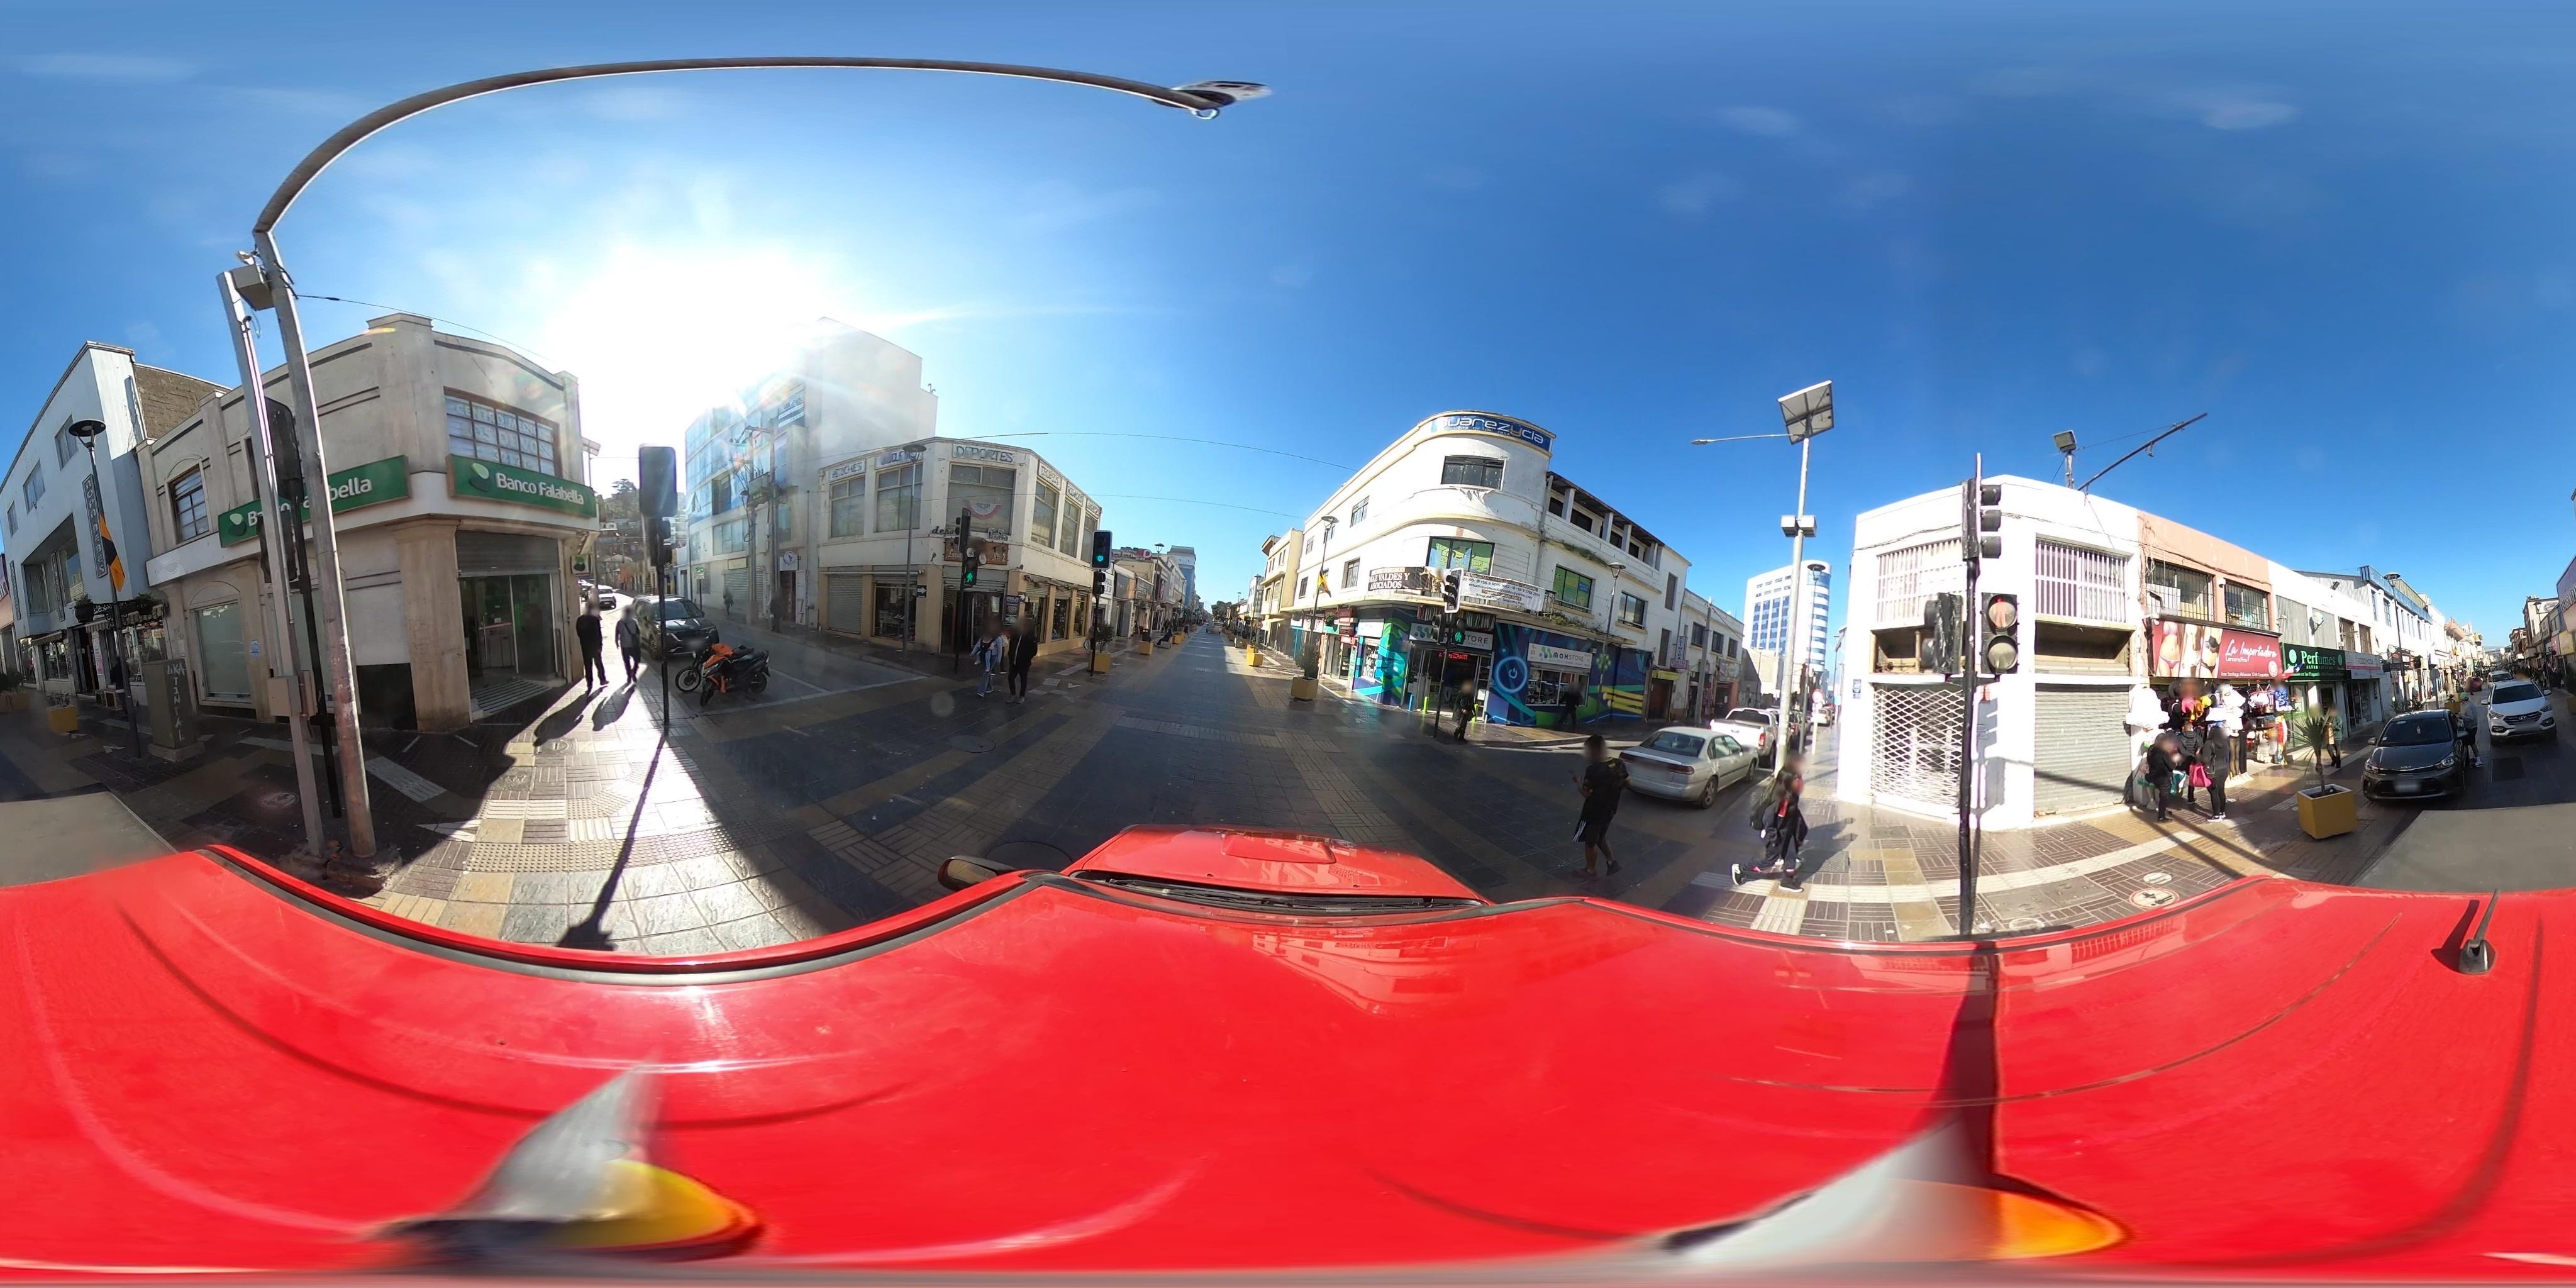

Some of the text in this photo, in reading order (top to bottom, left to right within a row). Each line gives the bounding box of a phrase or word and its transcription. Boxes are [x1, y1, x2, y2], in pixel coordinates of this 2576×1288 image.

[496, 472, 584, 504] Banco Falabella
[1379, 573, 1402, 581] VALDES
[1370, 581, 1402, 590] ASOCIADOS
[2225, 639, 2238, 656] La
[2300, 651, 2335, 665] Perfumes
